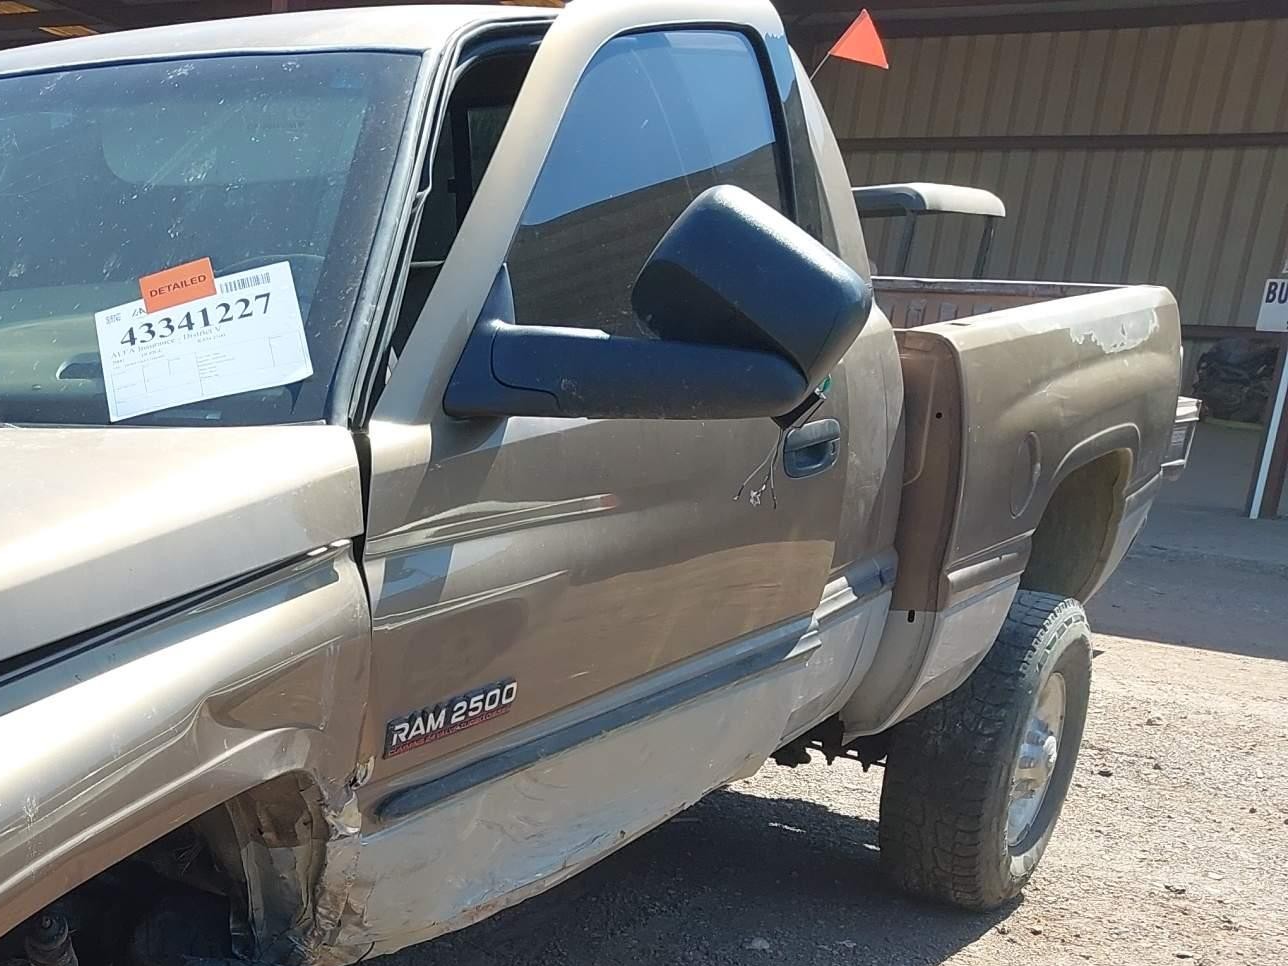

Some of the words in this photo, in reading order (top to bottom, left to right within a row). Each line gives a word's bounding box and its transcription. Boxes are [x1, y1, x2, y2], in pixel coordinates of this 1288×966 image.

[149, 274, 207, 298] DETAILED
[120, 292, 271, 346] 43341227
[392, 708, 446, 746] RAM
[451, 681, 518, 724] 2500
